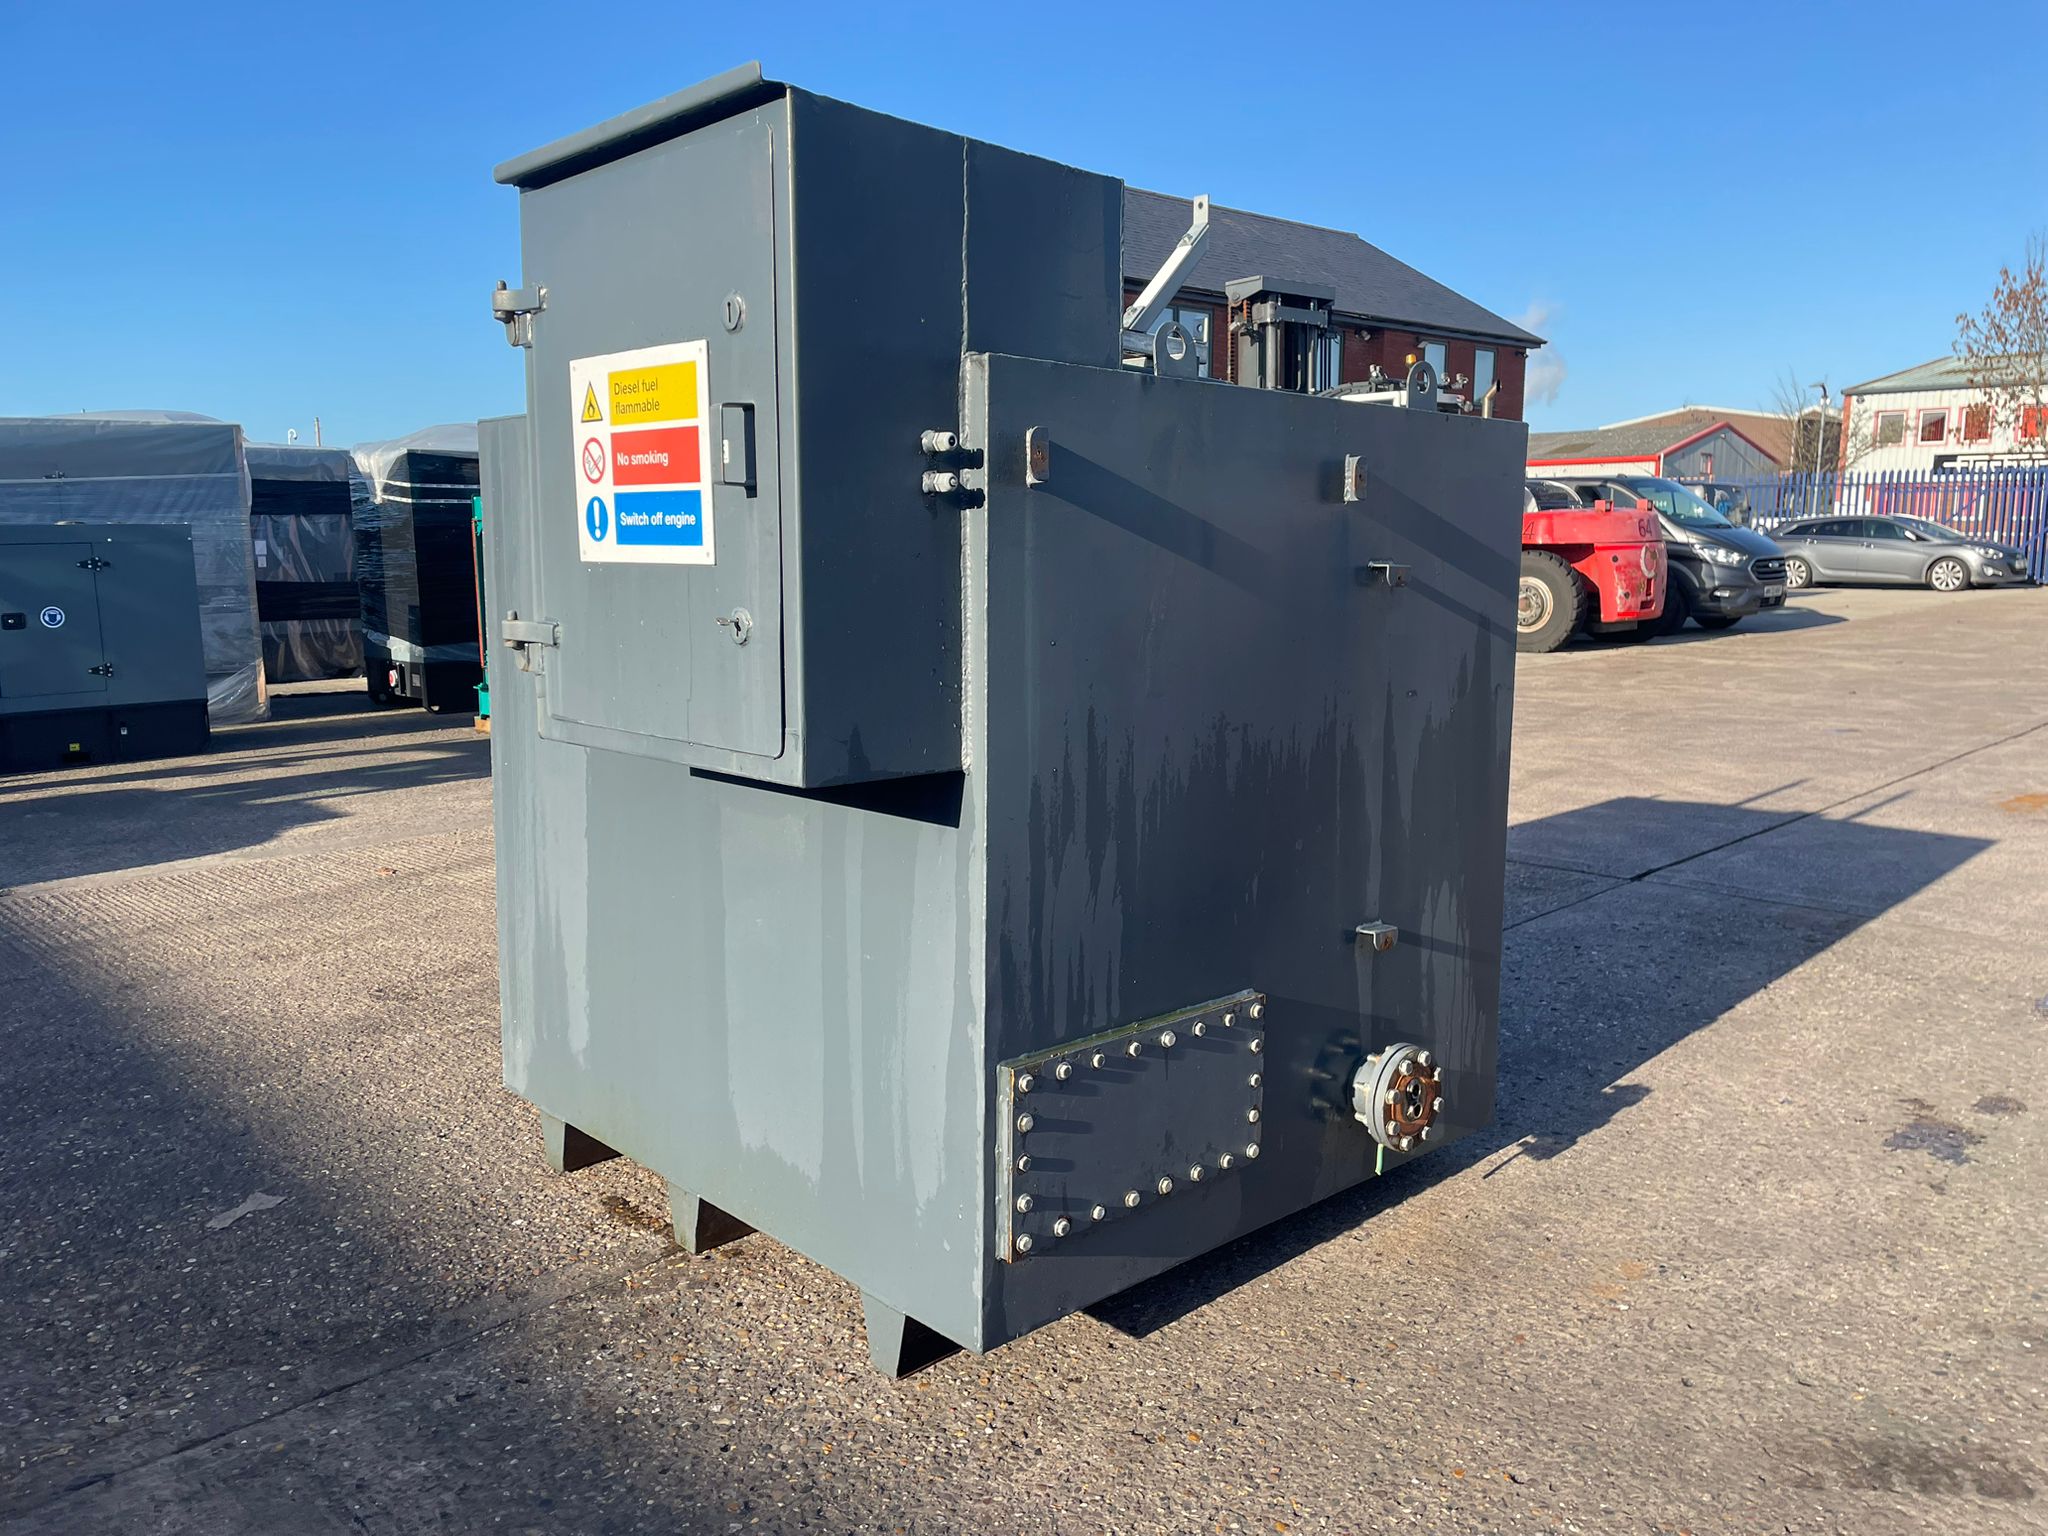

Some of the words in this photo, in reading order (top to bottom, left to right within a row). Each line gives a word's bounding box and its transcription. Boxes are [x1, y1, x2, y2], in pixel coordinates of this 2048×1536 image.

[614, 380, 640, 395] Diesel
[642, 378, 658, 391] fuel
[615, 399, 660, 415] flammable
[617, 453, 629, 466] No
[631, 450, 669, 467] smoking
[620, 512, 649, 526] Switch
[651, 512, 664, 526] off
[665, 512, 696, 528] engine
[1638, 518, 1653, 538] 64
